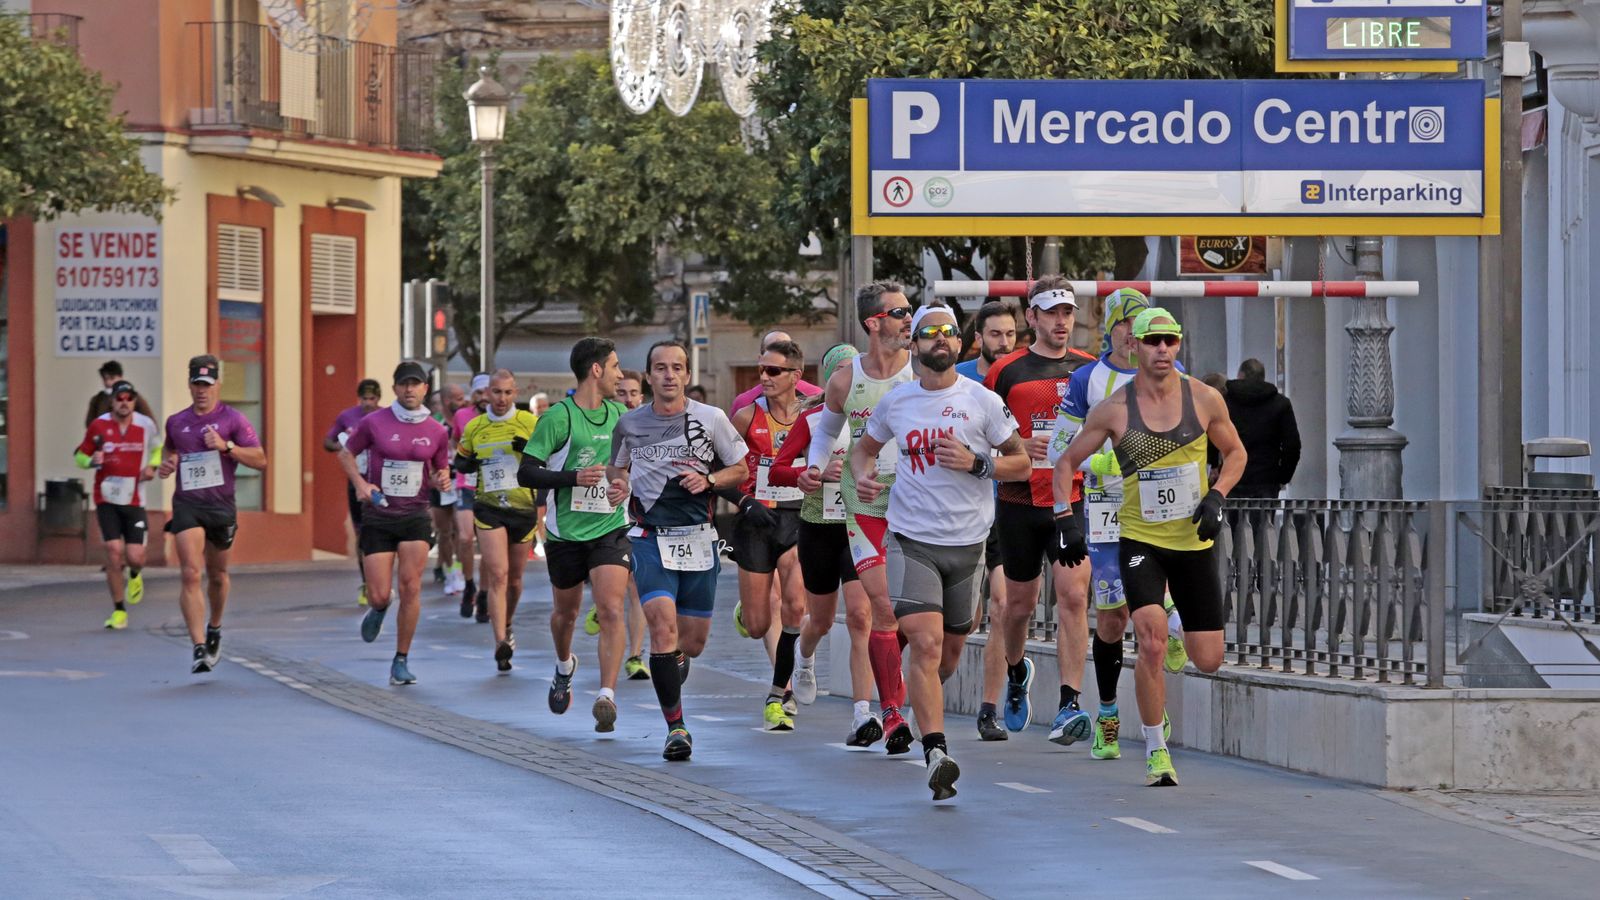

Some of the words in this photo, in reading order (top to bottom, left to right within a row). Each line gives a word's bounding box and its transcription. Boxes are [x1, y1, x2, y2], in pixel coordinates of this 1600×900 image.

[1342, 21, 1421, 47] LIBRE
[892, 91, 941, 159] P
[992, 98, 1231, 145] Mercado
[1328, 183, 1462, 205] Interparking
[59, 232, 83, 258] SE
[90, 232, 157, 258] VENDE
[56, 266, 159, 287] 610759173
[60, 316, 81, 330] POR
[85, 316, 141, 330] TRASLADO
[145, 335, 154, 351] 9
[188, 466, 206, 480] 789
[390, 474, 408, 486] 554
[489, 468, 505, 480] 363
[584, 486, 606, 499] 703
[1158, 488, 1176, 505] 50
[668, 544, 692, 558] 754
